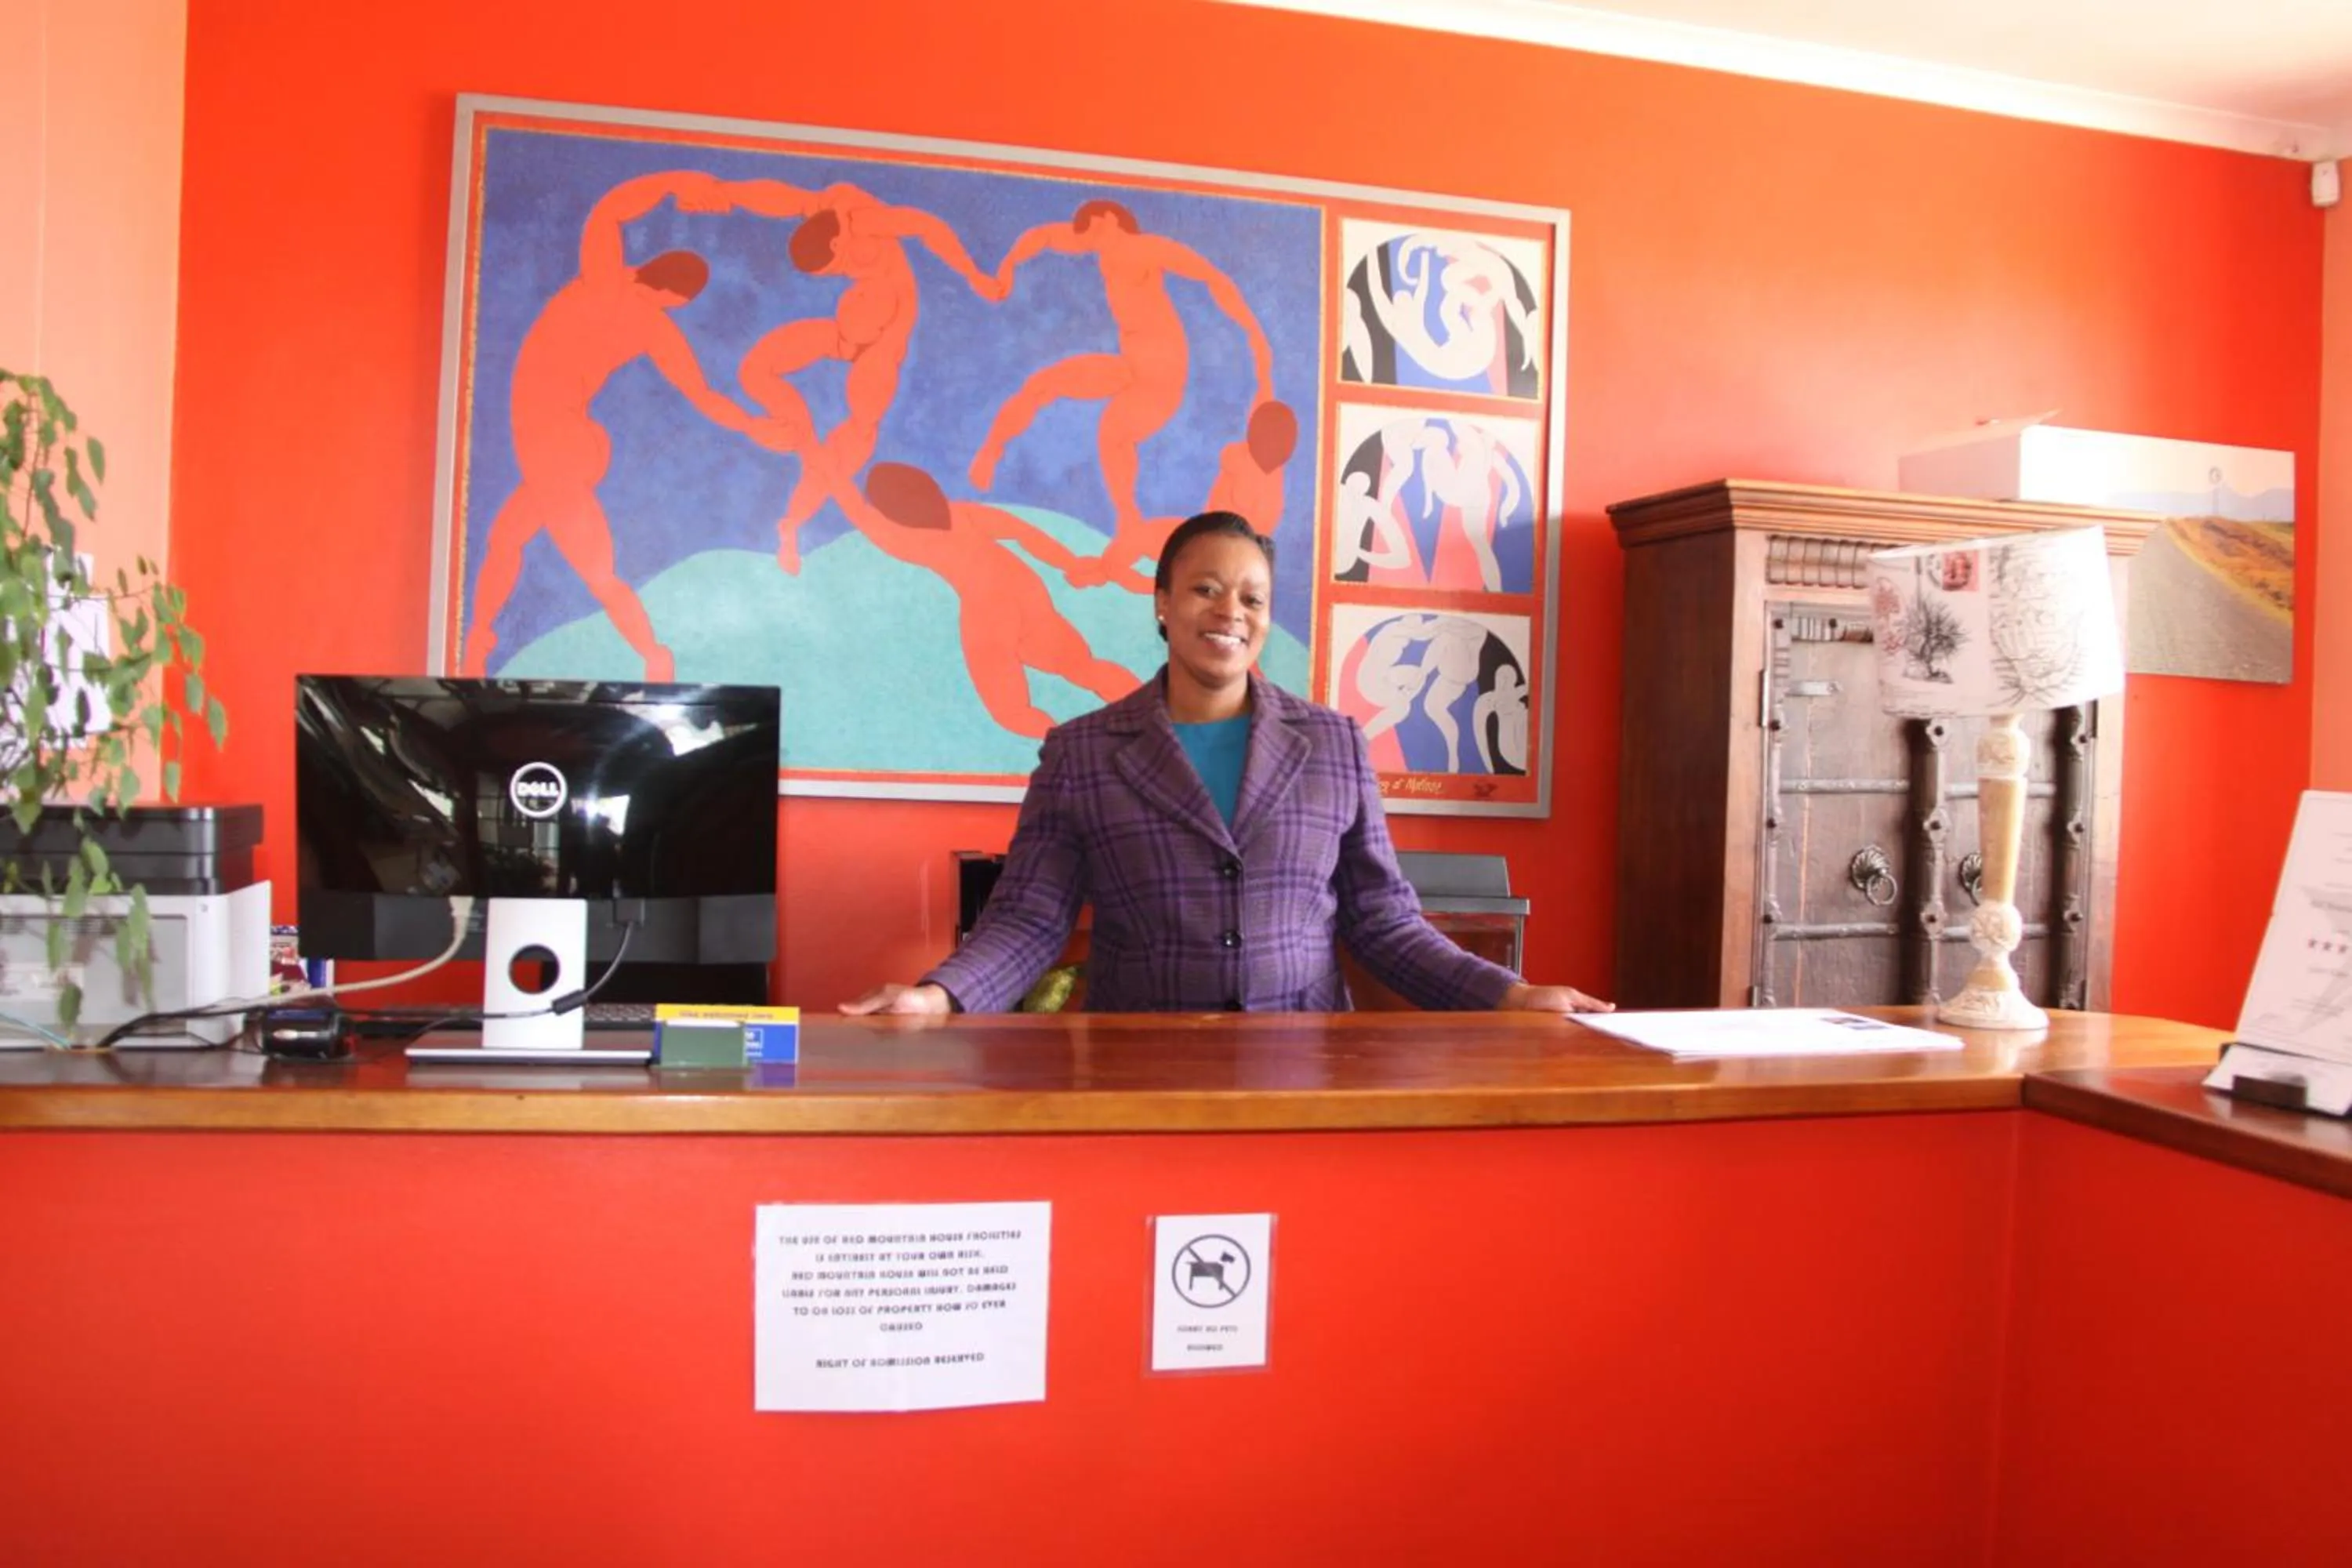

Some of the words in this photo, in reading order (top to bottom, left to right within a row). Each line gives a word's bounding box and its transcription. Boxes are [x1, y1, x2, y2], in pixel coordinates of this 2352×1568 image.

[517, 781, 560, 797] DELL
[779, 1236, 799, 1246] THE
[801, 1235, 820, 1246] USE
[822, 1235, 837, 1245] OF
[841, 1234, 865, 1244] RED
[867, 1233, 927, 1244] MOUNTAIN
[929, 1232, 964, 1243] HOUSE
[878, 1252, 892, 1261] AT
[896, 1251, 925, 1261] YOUR
[927, 1250, 955, 1261] OWN
[791, 1271, 814, 1281] RED
[816, 1270, 876, 1280] MOUNTAIN
[879, 1269, 914, 1279] HOUSE
[916, 1269, 939, 1279] WILL
[942, 1267, 964, 1277] NOT
[967, 1266, 980, 1276] BE
[982, 1265, 1009, 1275] HELD
[818, 1288, 841, 1298] FOR
[844, 1288, 865, 1298] ANY
[867, 1287, 921, 1298] PERSONAL
[967, 1282, 1017, 1294] DAMAGES
[793, 1306, 809, 1316] TO
[811, 1306, 829, 1316] OR
[831, 1305, 855, 1316] LOSS
[858, 1305, 873, 1316] OF
[877, 1304, 932, 1315] PROPERTY
[935, 1302, 962, 1312] HOW
[964, 1301, 979, 1311] SO
[981, 1299, 1007, 1310] EVER
[879, 1321, 924, 1332] CAUSED
[815, 1358, 849, 1369] RIGHT
[851, 1358, 866, 1368] OF
[869, 1356, 931, 1367] ADMISSION
[934, 1352, 985, 1365] RESERVED
